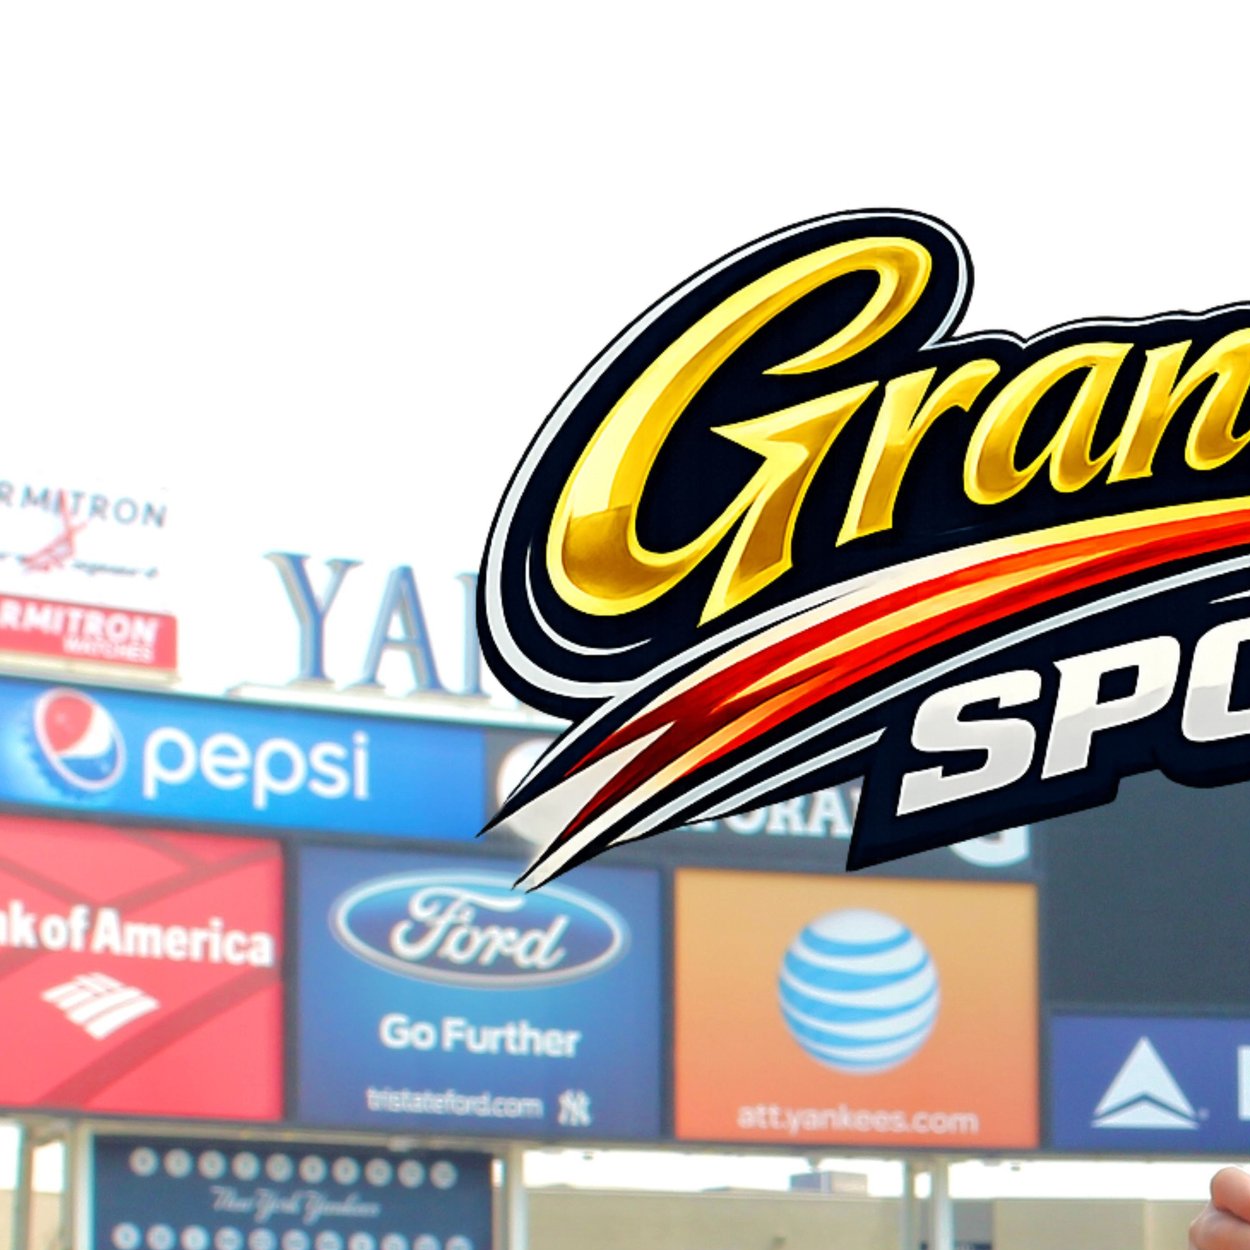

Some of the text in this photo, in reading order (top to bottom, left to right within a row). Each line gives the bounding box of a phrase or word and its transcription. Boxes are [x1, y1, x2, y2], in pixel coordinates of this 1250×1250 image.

[142, 727, 370, 809] pepsi
[40, 902, 93, 952] of
[91, 905, 275, 968] America
[390, 886, 571, 970] Ford
[379, 1013, 581, 1058] Go Further
[737, 1103, 980, 1136] att.yankees.com
